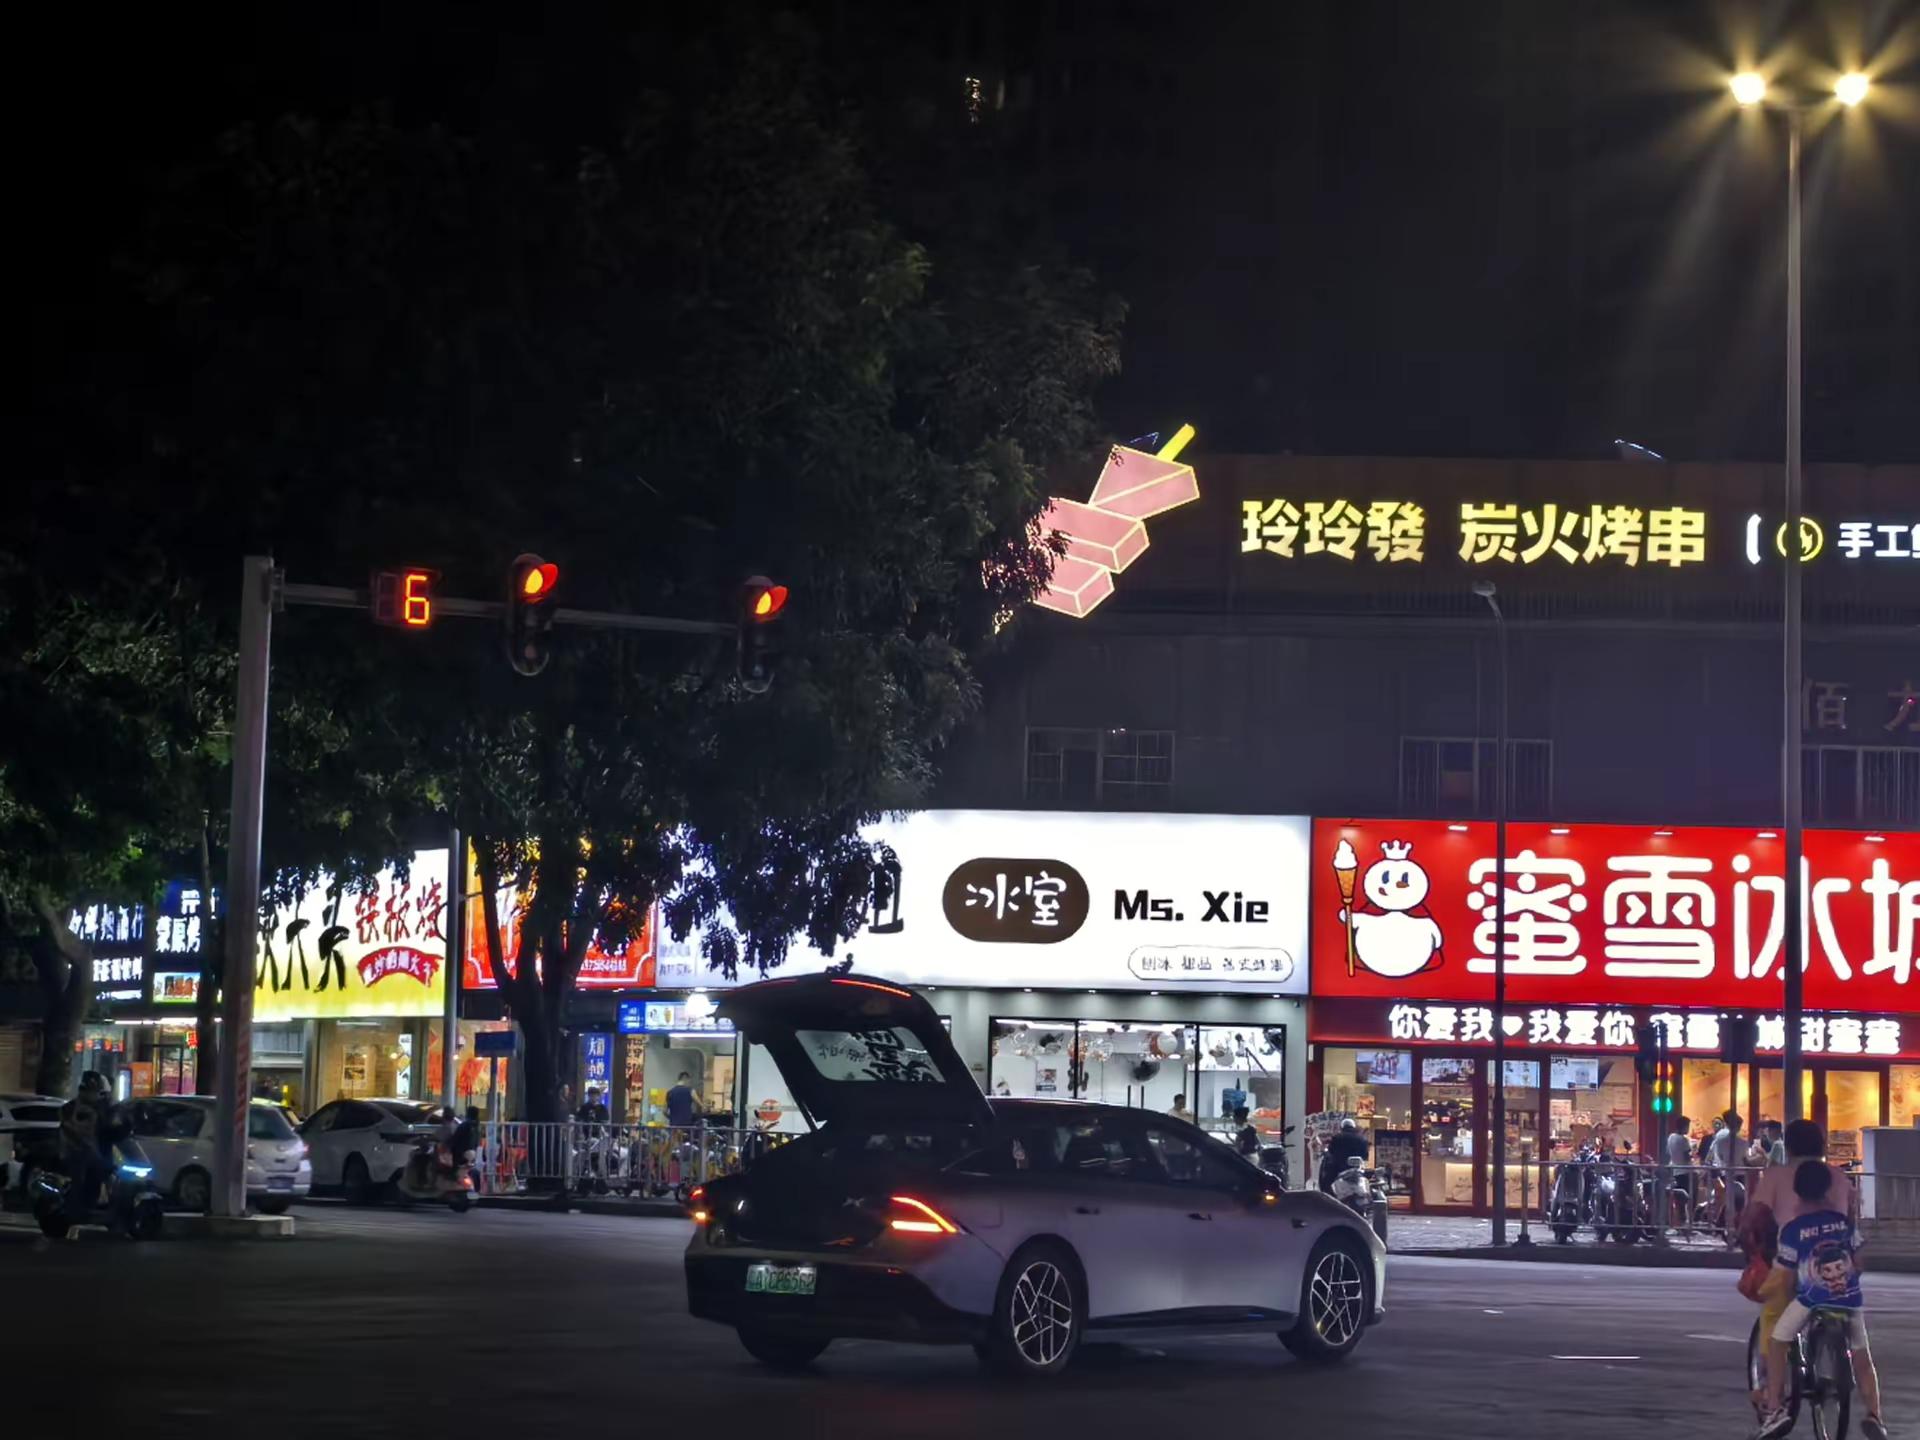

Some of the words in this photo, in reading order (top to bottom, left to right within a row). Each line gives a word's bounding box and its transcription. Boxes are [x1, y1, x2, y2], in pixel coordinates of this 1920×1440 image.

[1241, 498, 1426, 563] 玲玲發
[1458, 502, 1706, 568] 炭火烤串
[1838, 521, 1920, 559] 手工
[404, 573, 431, 625] 6
[964, 870, 1068, 927] 冰室
[1114, 888, 1184, 923] Ms.
[1200, 889, 1269, 923] Xie
[1388, 1003, 1495, 1041] 你爱我
[1527, 1006, 1636, 1046] 我爱你
